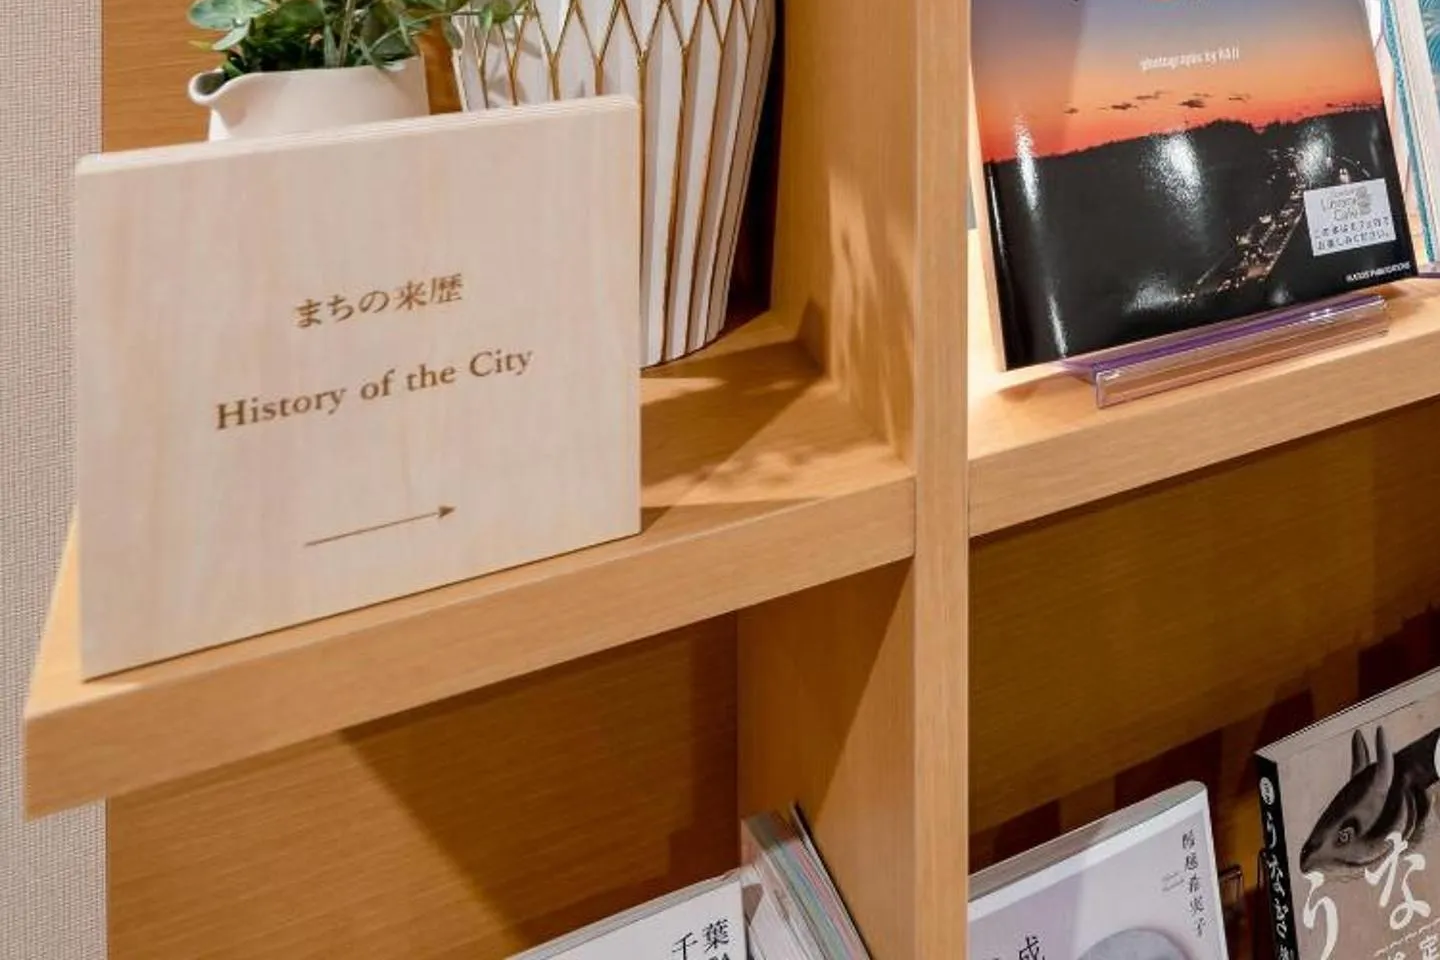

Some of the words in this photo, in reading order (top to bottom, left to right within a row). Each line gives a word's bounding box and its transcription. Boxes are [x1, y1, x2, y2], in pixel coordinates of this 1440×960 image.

[294, 272, 464, 329] まちの来歴
[215, 388, 347, 430] History
[359, 368, 397, 401] of
[406, 363, 457, 392] the
[468, 349, 534, 376] City
